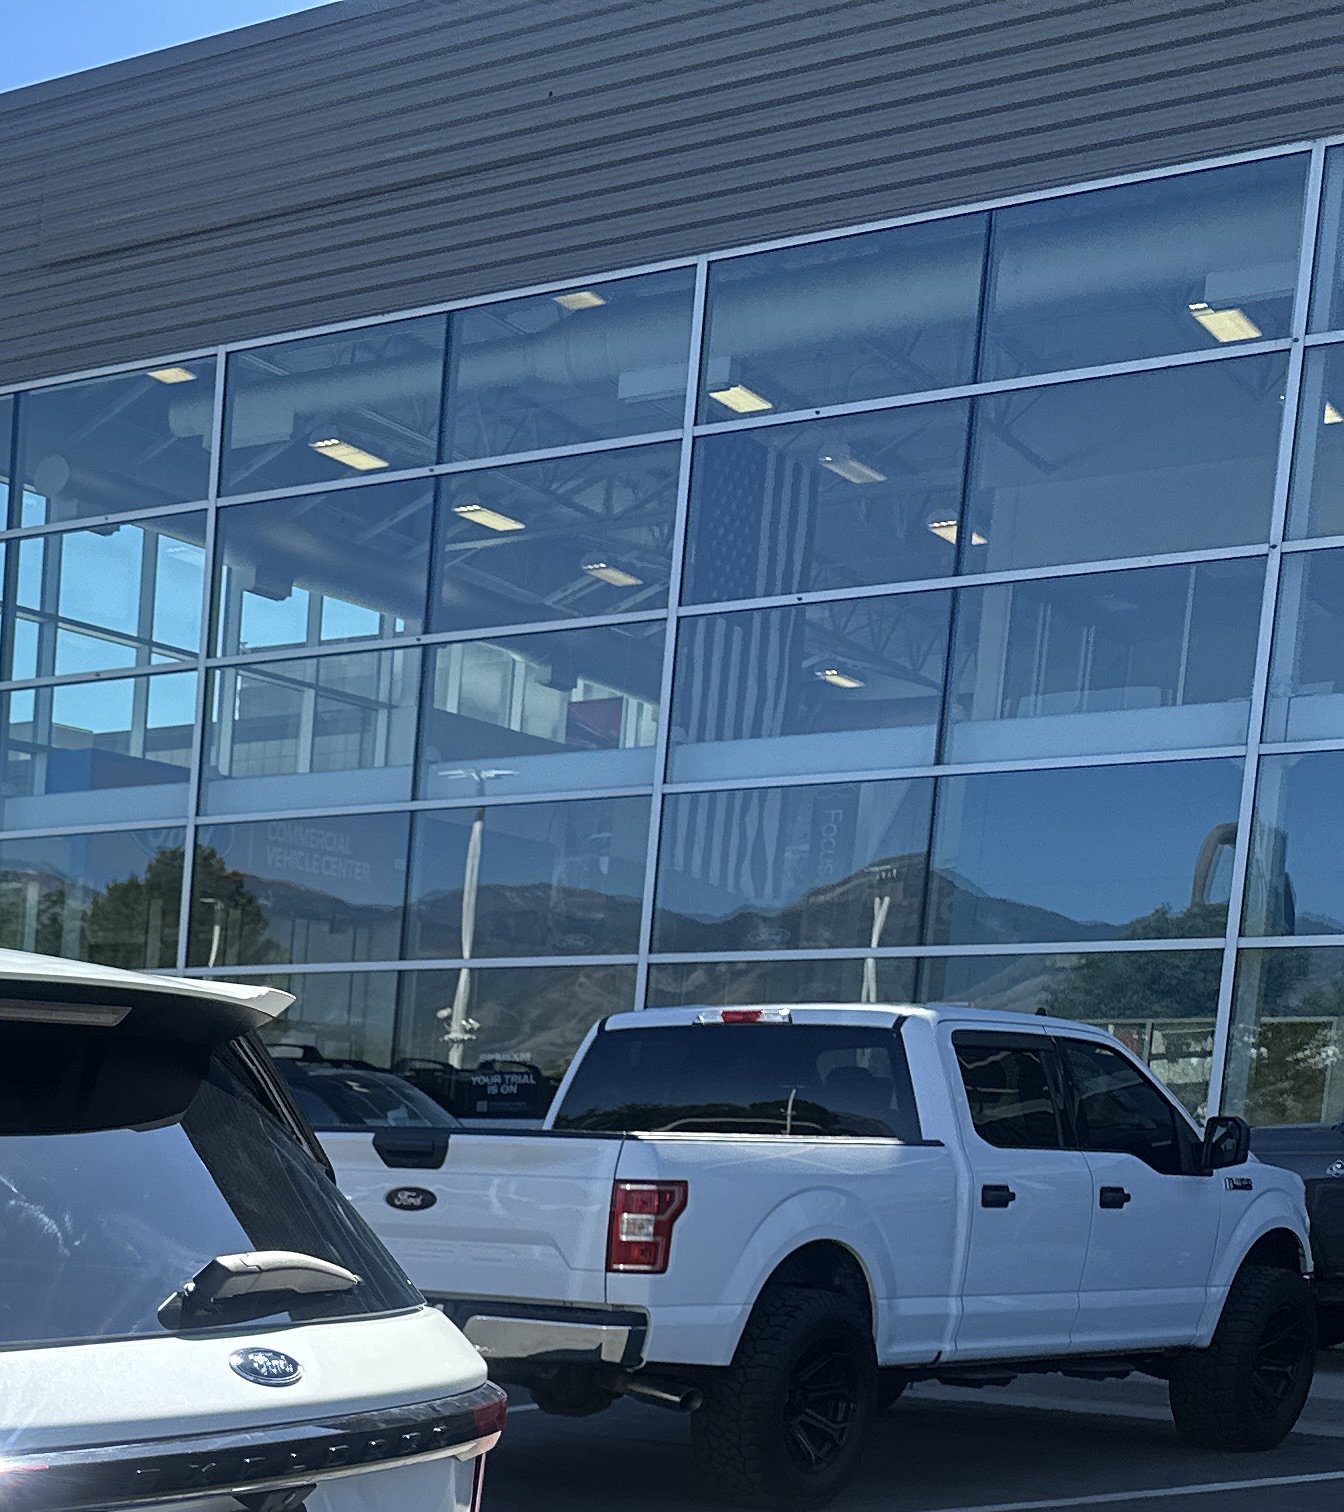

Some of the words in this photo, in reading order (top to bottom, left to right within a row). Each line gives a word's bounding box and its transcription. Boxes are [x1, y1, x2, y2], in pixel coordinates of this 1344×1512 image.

[267, 822, 352, 855] COMMERCIAL
[266, 846, 320, 875] VEHICLE
[321, 857, 371, 881] CENTER
[471, 1074, 501, 1085] YOUR
[503, 1073, 536, 1085] TRIAL
[500, 1084, 518, 1095] ON
[394, 1190, 423, 1206] Ford
